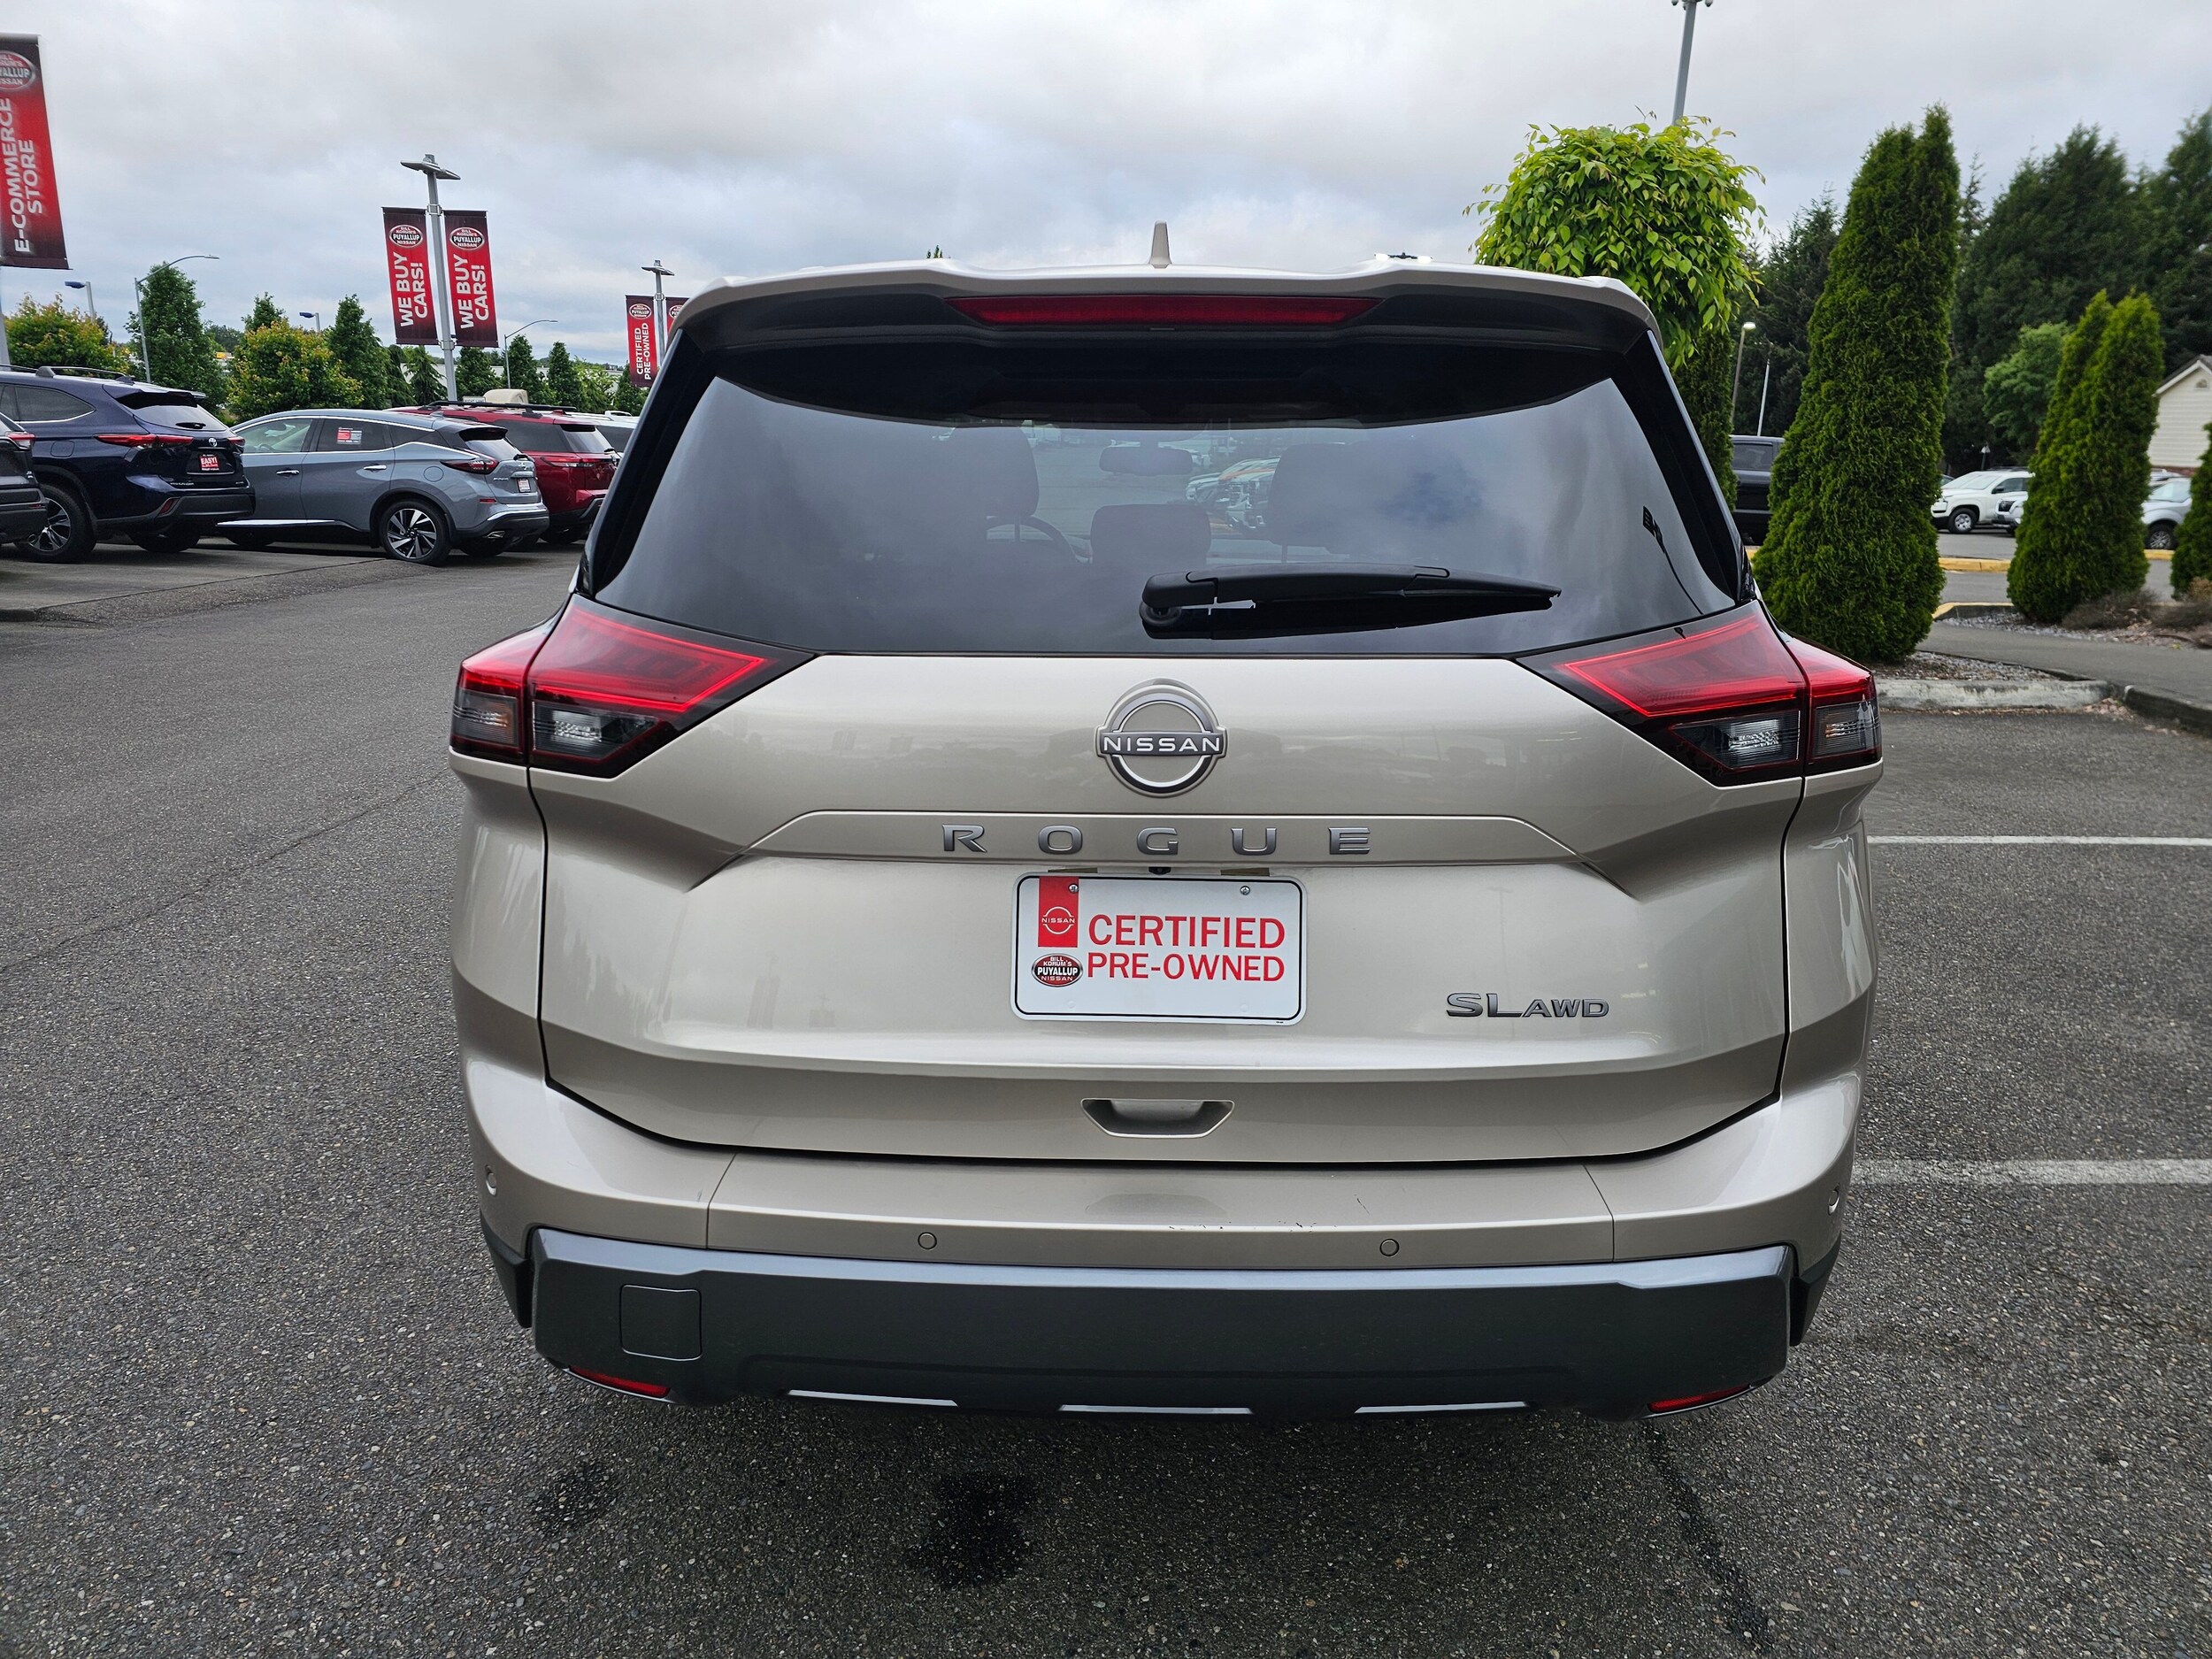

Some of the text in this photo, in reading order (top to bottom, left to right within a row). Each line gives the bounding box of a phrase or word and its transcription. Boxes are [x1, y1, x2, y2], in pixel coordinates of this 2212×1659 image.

[19, 139, 43, 215] STORE
[393, 251, 414, 326] WE BUY
[411, 262, 428, 319] CARS!
[453, 254, 474, 329] WE BUY
[472, 265, 489, 321] CARS!
[634, 327, 644, 375] CERTIFIED
[641, 322, 651, 380] PRE-OWNED
[1103, 735, 1221, 753] NISSAN
[942, 823, 1371, 856] ROGUE
[1088, 914, 1285, 949] CERTIFIED
[1037, 967, 1079, 976] PUYALLUP
[1087, 952, 1285, 982] PRE-OWNED
